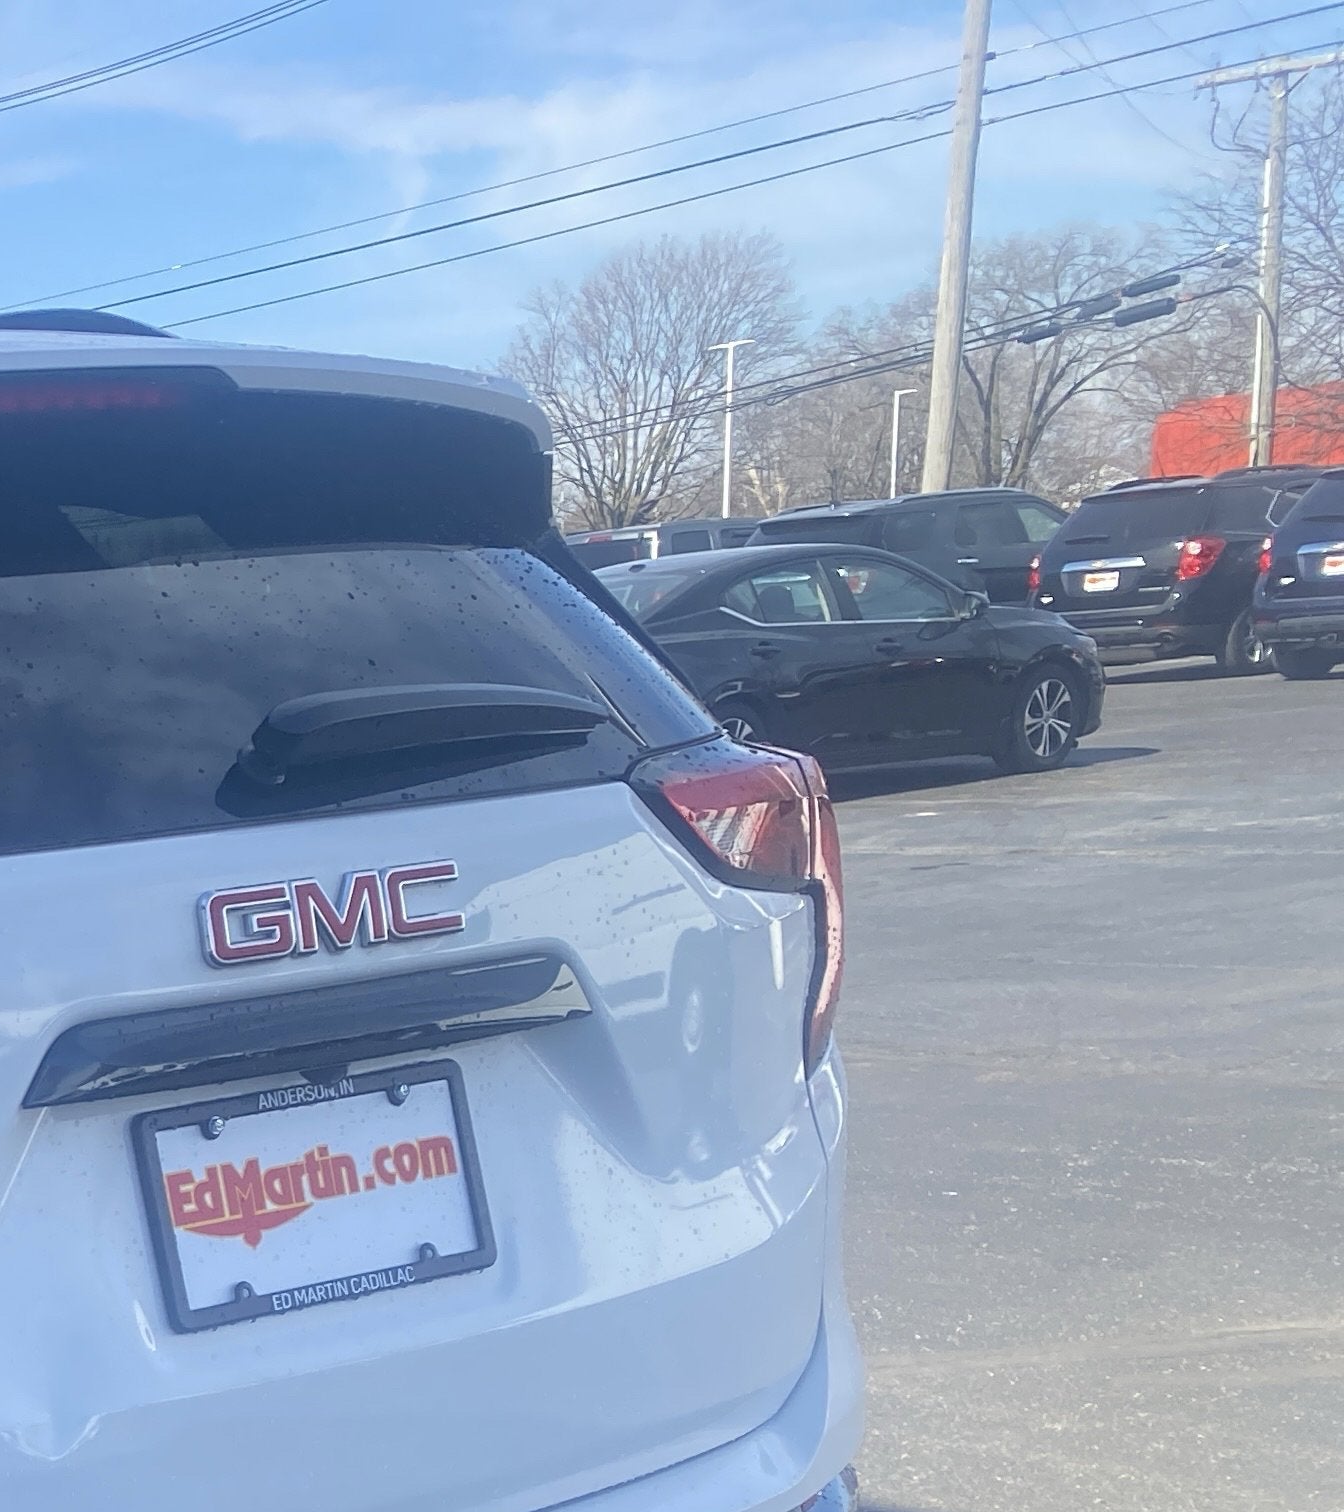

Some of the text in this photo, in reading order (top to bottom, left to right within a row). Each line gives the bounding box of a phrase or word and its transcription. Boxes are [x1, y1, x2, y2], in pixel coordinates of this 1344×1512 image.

[198, 858, 466, 969] GMC
[338, 1078, 355, 1096] IN
[165, 1136, 458, 1230] EdMartin.com
[272, 1265, 417, 1312] ED MARTIN CADILLAC
